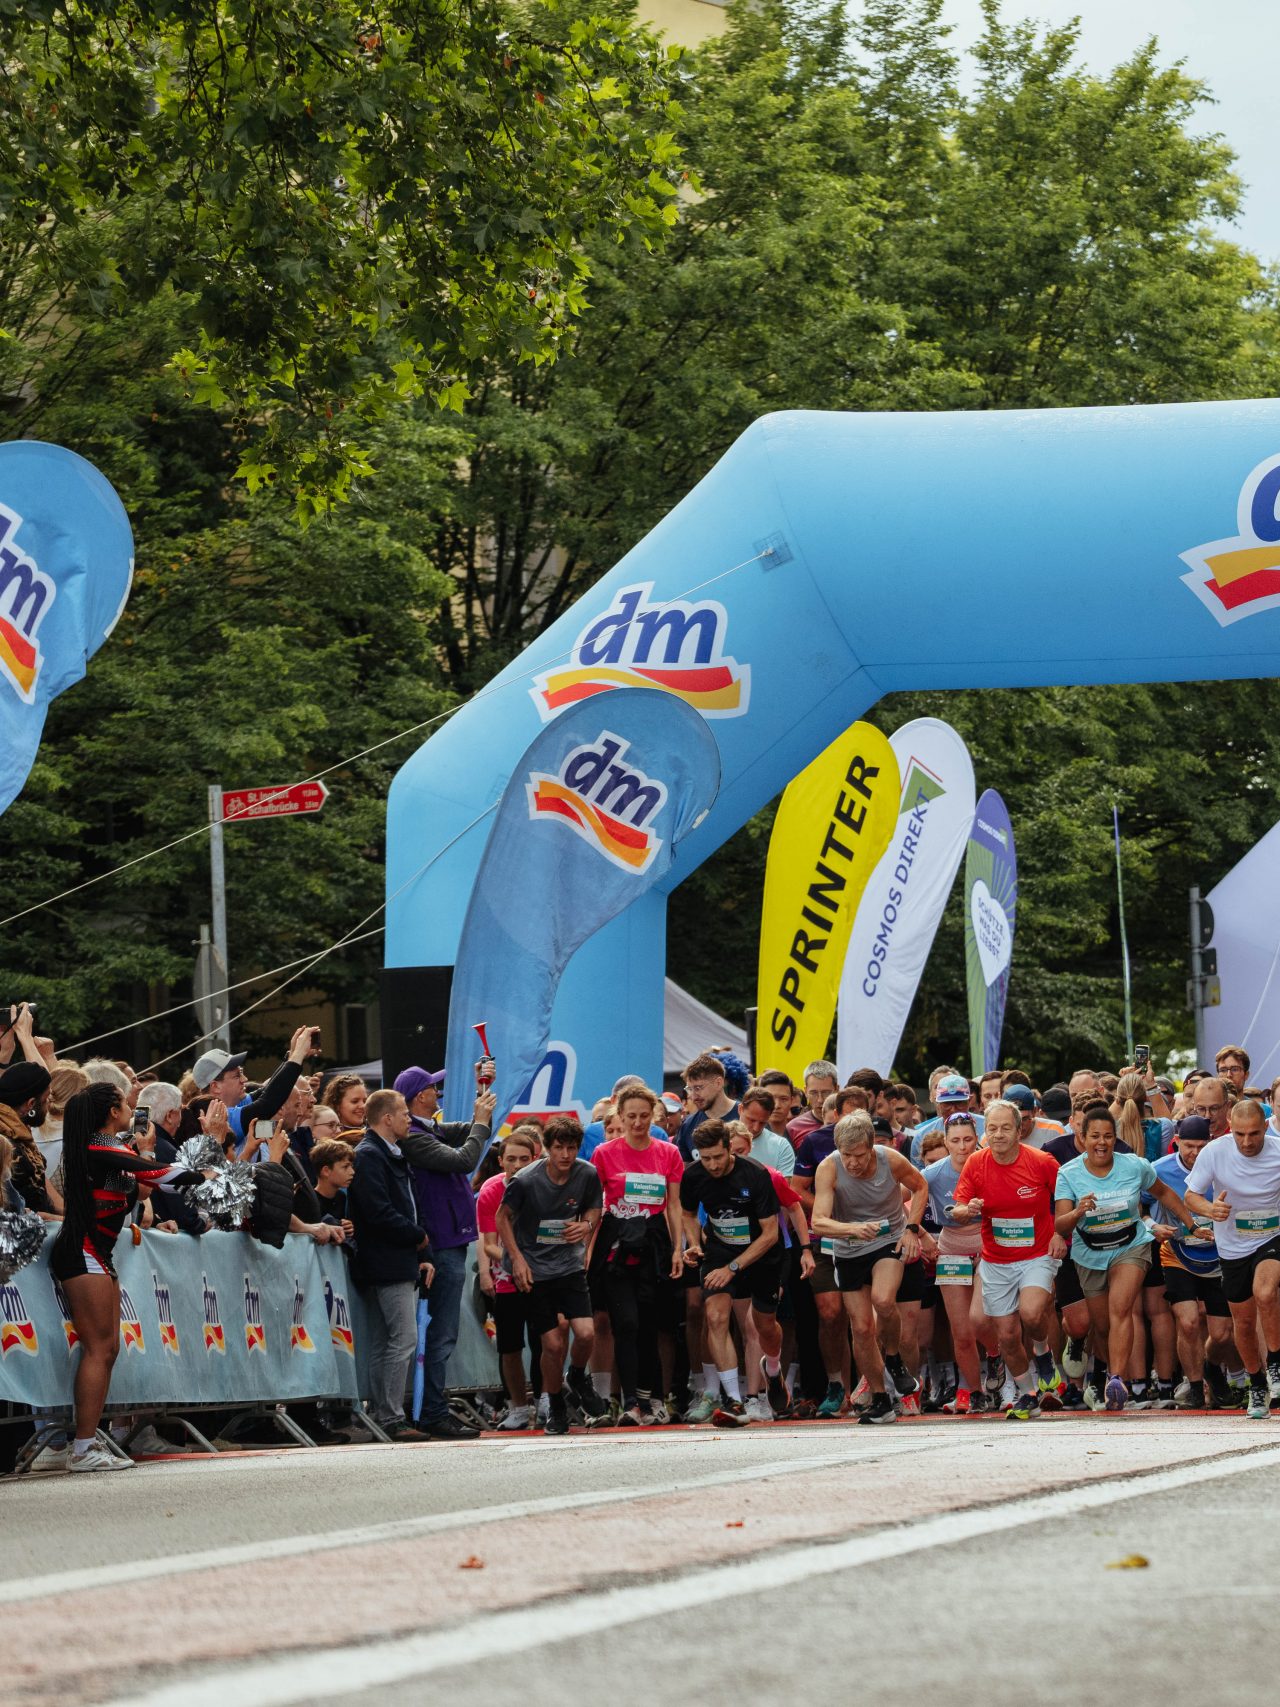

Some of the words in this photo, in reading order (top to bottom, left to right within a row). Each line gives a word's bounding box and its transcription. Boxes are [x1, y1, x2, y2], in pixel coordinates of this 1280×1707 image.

[0, 513, 47, 639] m
[579, 590, 718, 666] dm
[564, 738, 661, 828] dm
[771, 755, 881, 1052] SPRINTER
[863, 886, 902, 998] COSMOS
[894, 786, 930, 885] DIREKT
[633, 1182, 659, 1191] Valentina
[153, 1275, 172, 1323] dm
[203, 1276, 220, 1324] dm
[245, 1278, 261, 1324] dm
[294, 1279, 304, 1325] dm
